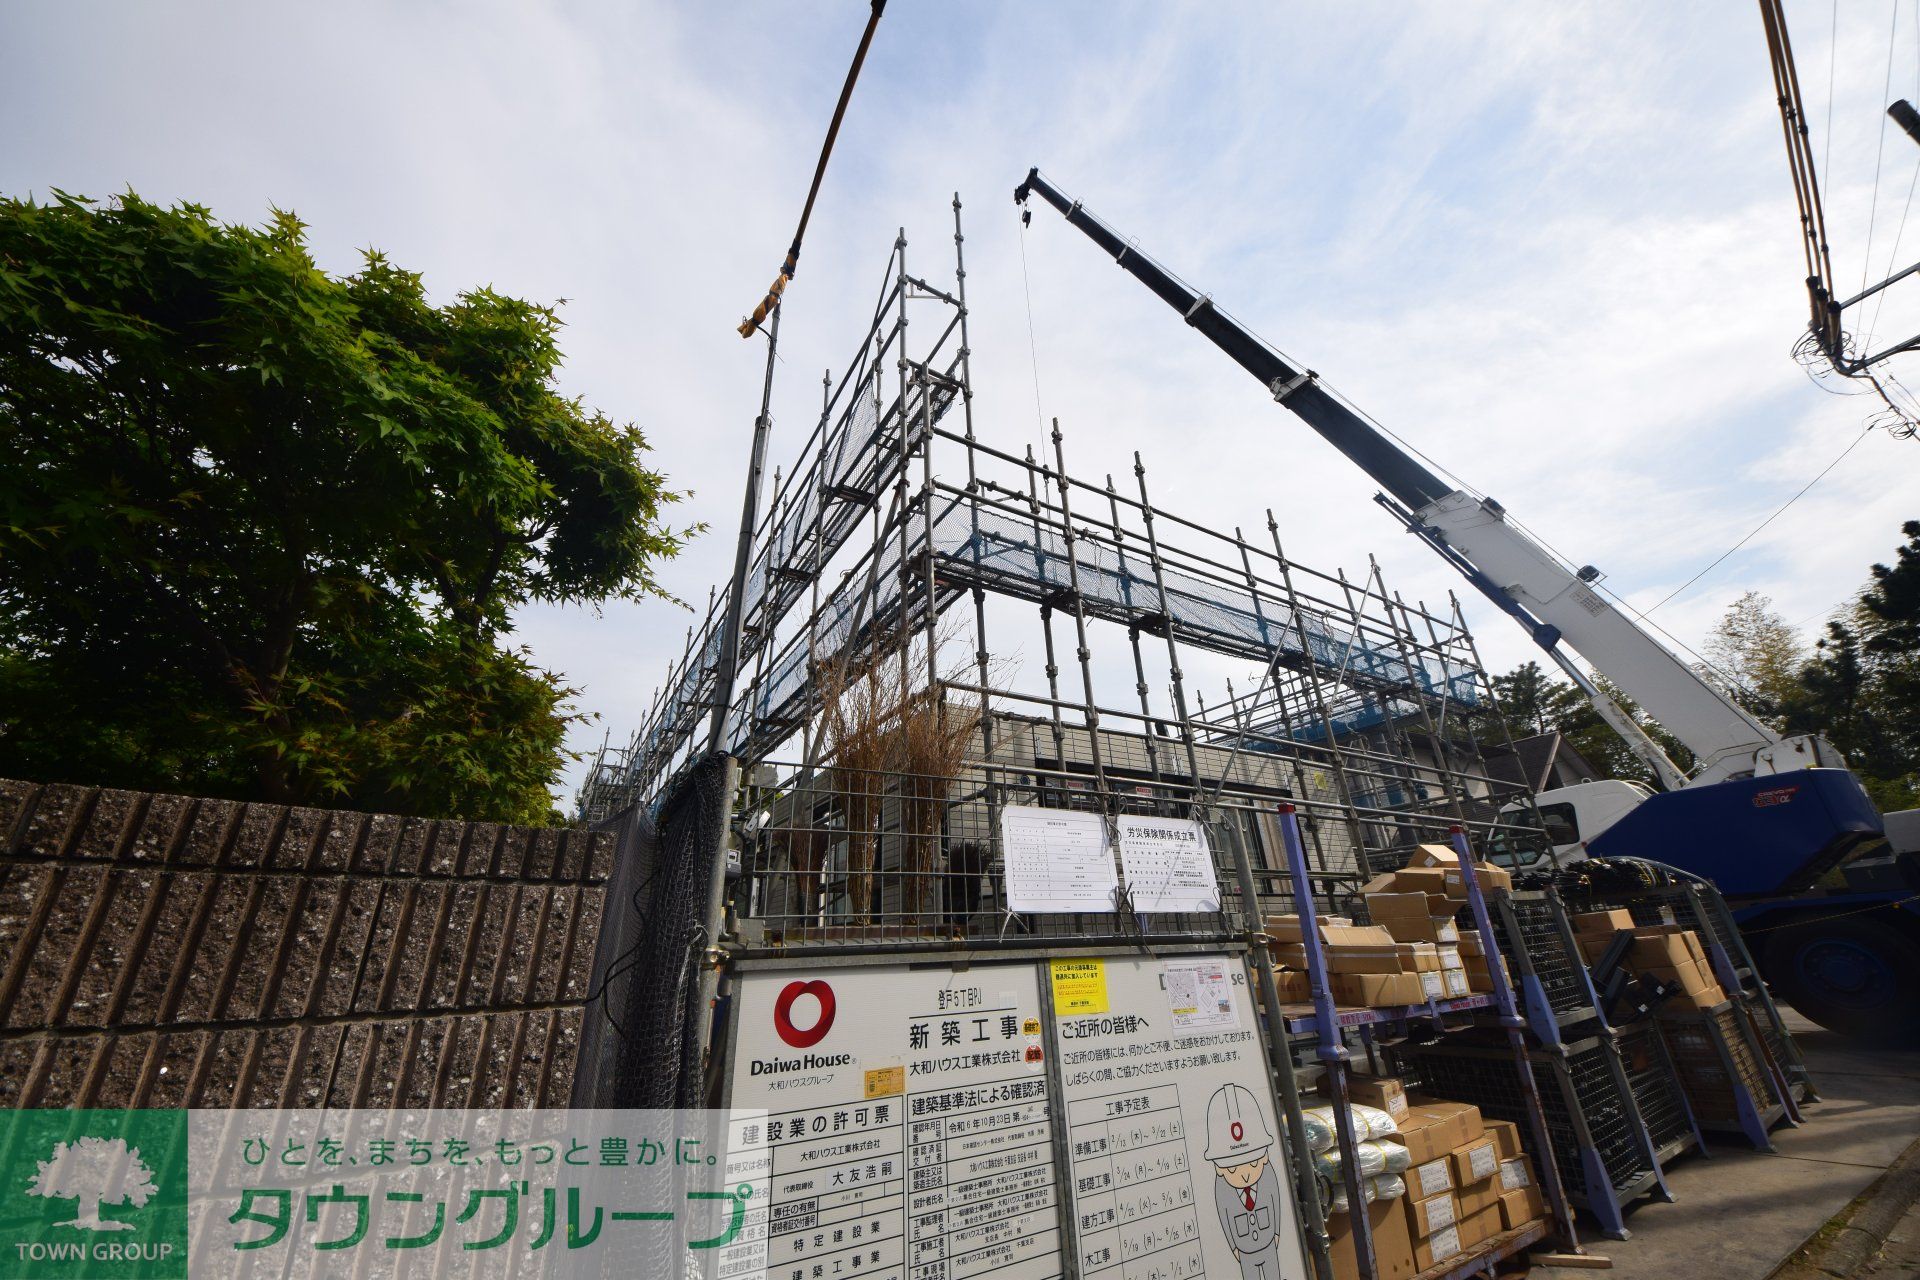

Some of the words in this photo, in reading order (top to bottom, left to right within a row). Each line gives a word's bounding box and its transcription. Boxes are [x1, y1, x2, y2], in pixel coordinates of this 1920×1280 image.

[1127, 827, 1197, 842] 労災保険関係成立票
[909, 1015, 1018, 1050] 新築工事
[1062, 1015, 1149, 1039] ご近所の皆様へ
[750, 1057, 801, 1076] Daiwa
[803, 1053, 851, 1070] House
[909, 1049, 1021, 1077] 大和ハウス工業株式会社
[767, 1074, 834, 1092] 大和ハウスグループ
[912, 1080, 1045, 1116] 建築基準法による確認済
[1106, 1096, 1150, 1116] 工事予定表
[742, 1105, 890, 1145] 建設業の許可票
[800, 1139, 881, 1163] 大和ハウス工業株式会社
[1075, 1138, 1107, 1156] 準備工事
[832, 1161, 892, 1186] 大友浩嗣
[1078, 1173, 1111, 1193] 基礎工事
[773, 1200, 816, 1218] 専任の有無
[914, 1194, 943, 1209] 設計者氏名
[1081, 1208, 1115, 1230] 建方工事
[793, 1221, 880, 1252] 特定建設業
[955, 1221, 1010, 1242] 大和ハウス工業株式会社
[955, 1245, 1011, 1267] 大和ハウス工業株式会社
[1085, 1247, 1111, 1267] 木工事
